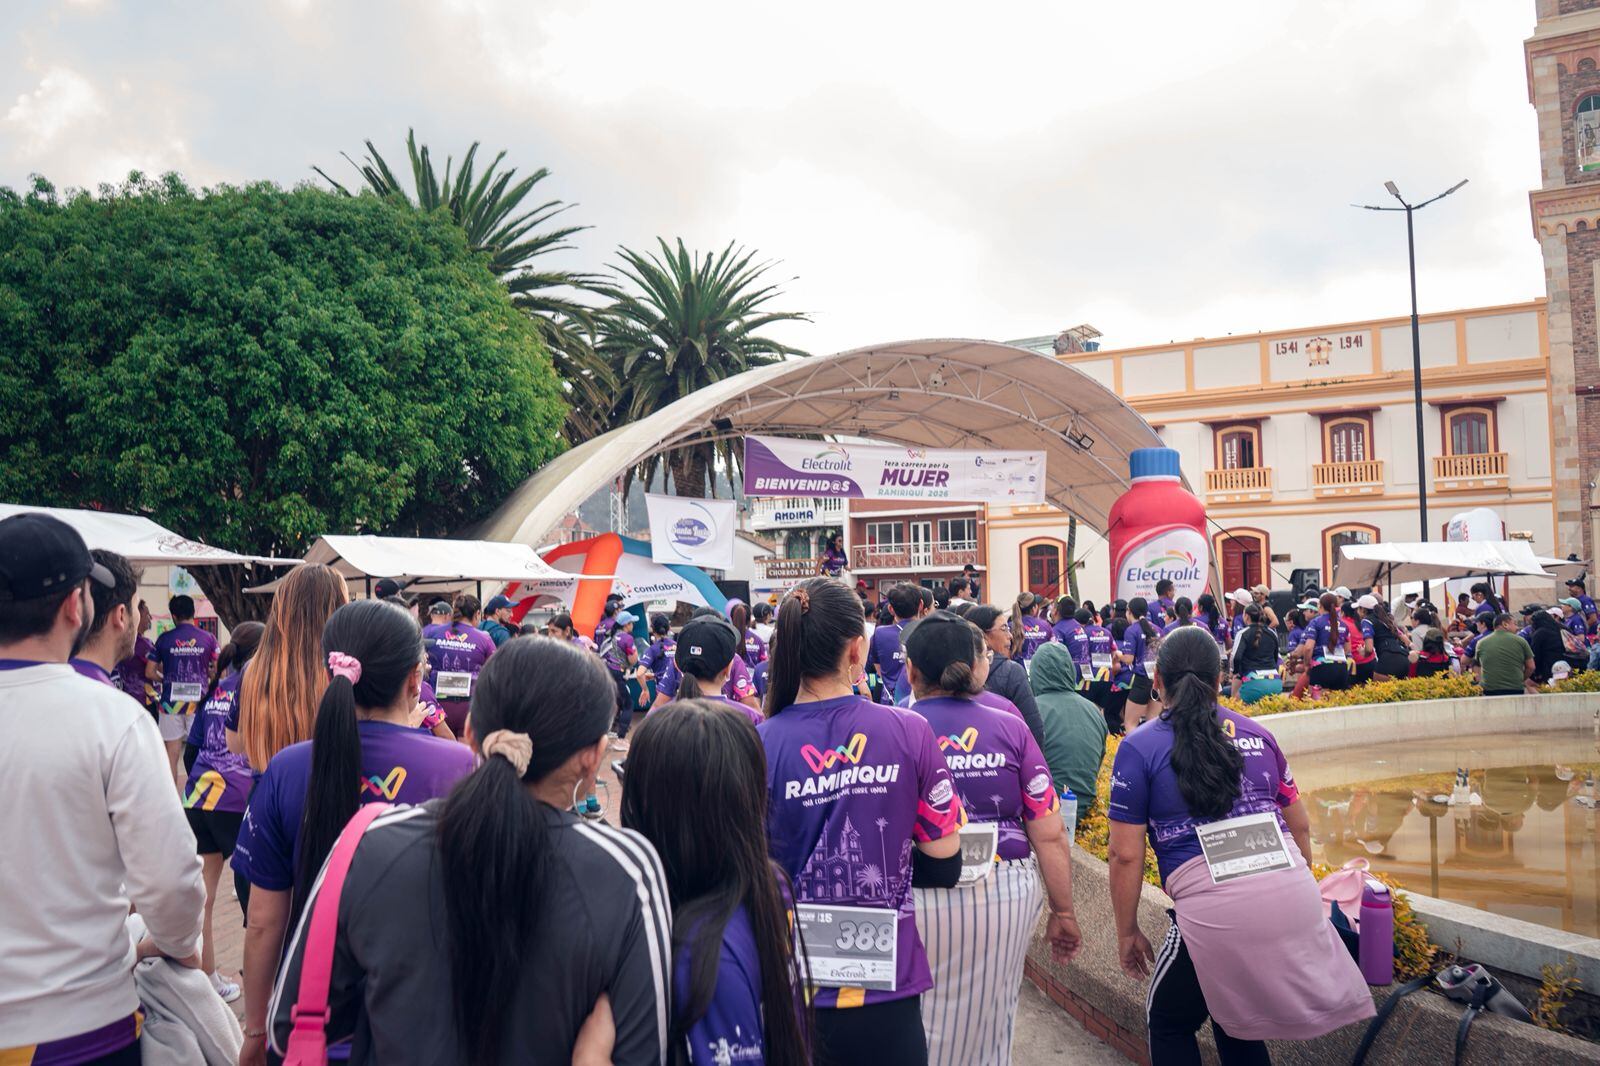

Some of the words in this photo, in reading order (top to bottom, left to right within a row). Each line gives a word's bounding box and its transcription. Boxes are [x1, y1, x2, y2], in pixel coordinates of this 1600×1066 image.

[802, 458, 853, 471] Electrolit
[755, 477, 851, 494] BIENVENID@S
[880, 468, 950, 487] MUJER
[1127, 567, 1201, 582] Electrolit
[634, 583, 683, 593] comfaboy
[835, 920, 894, 953] 388
